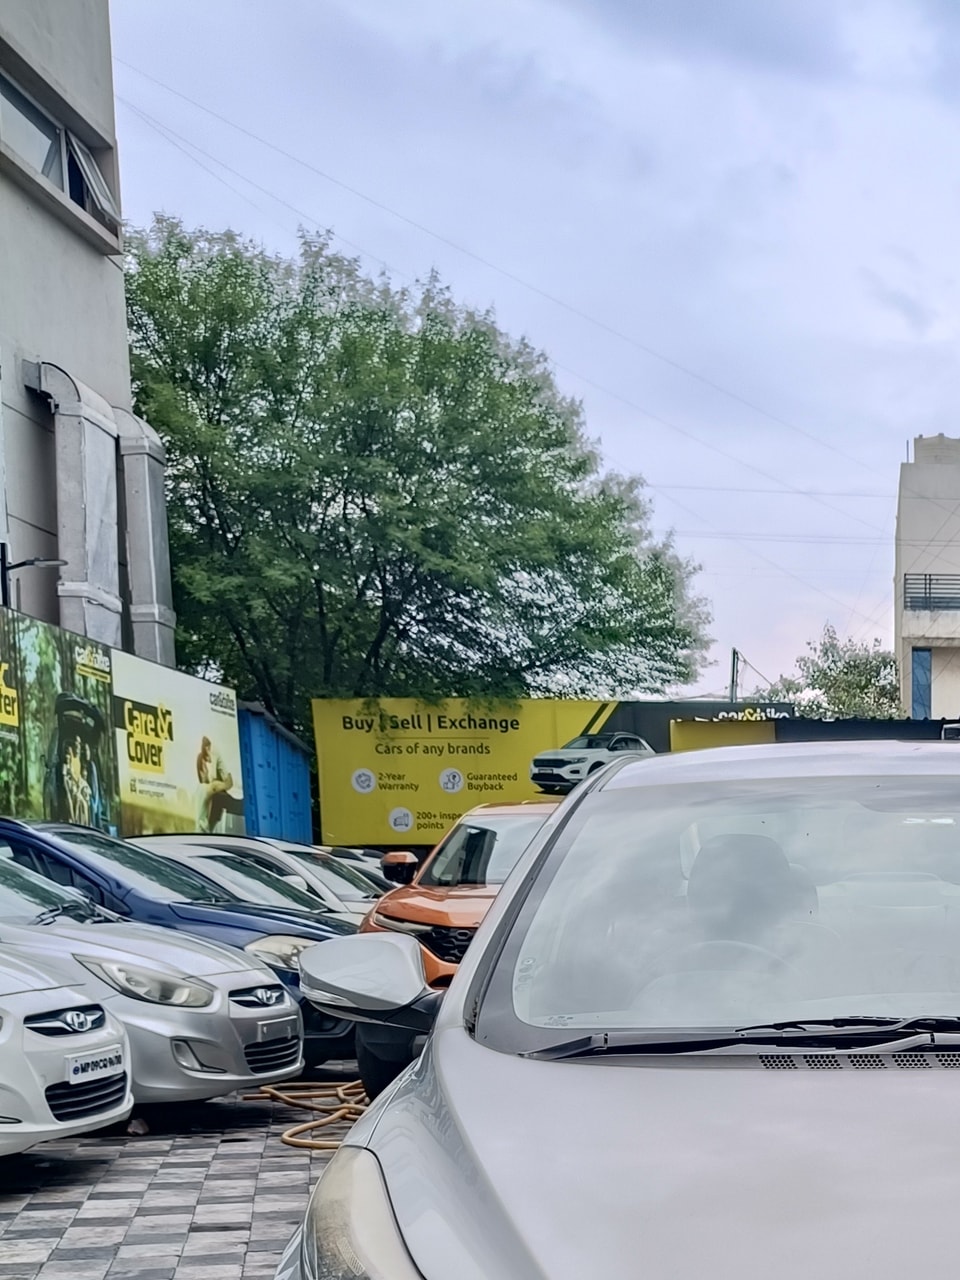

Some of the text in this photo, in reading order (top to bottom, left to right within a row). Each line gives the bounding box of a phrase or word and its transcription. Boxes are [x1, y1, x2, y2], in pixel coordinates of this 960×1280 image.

[124, 701, 156, 736] Care
[342, 716, 374, 733] Buy
[390, 714, 423, 730] Sell
[437, 714, 520, 733] Exchange
[127, 731, 162, 767] Cover
[375, 743, 490, 756] Cars of any brands
[379, 783, 419, 791] Warranty
[468, 782, 503, 792] Buyback
[417, 822, 444, 830] points
